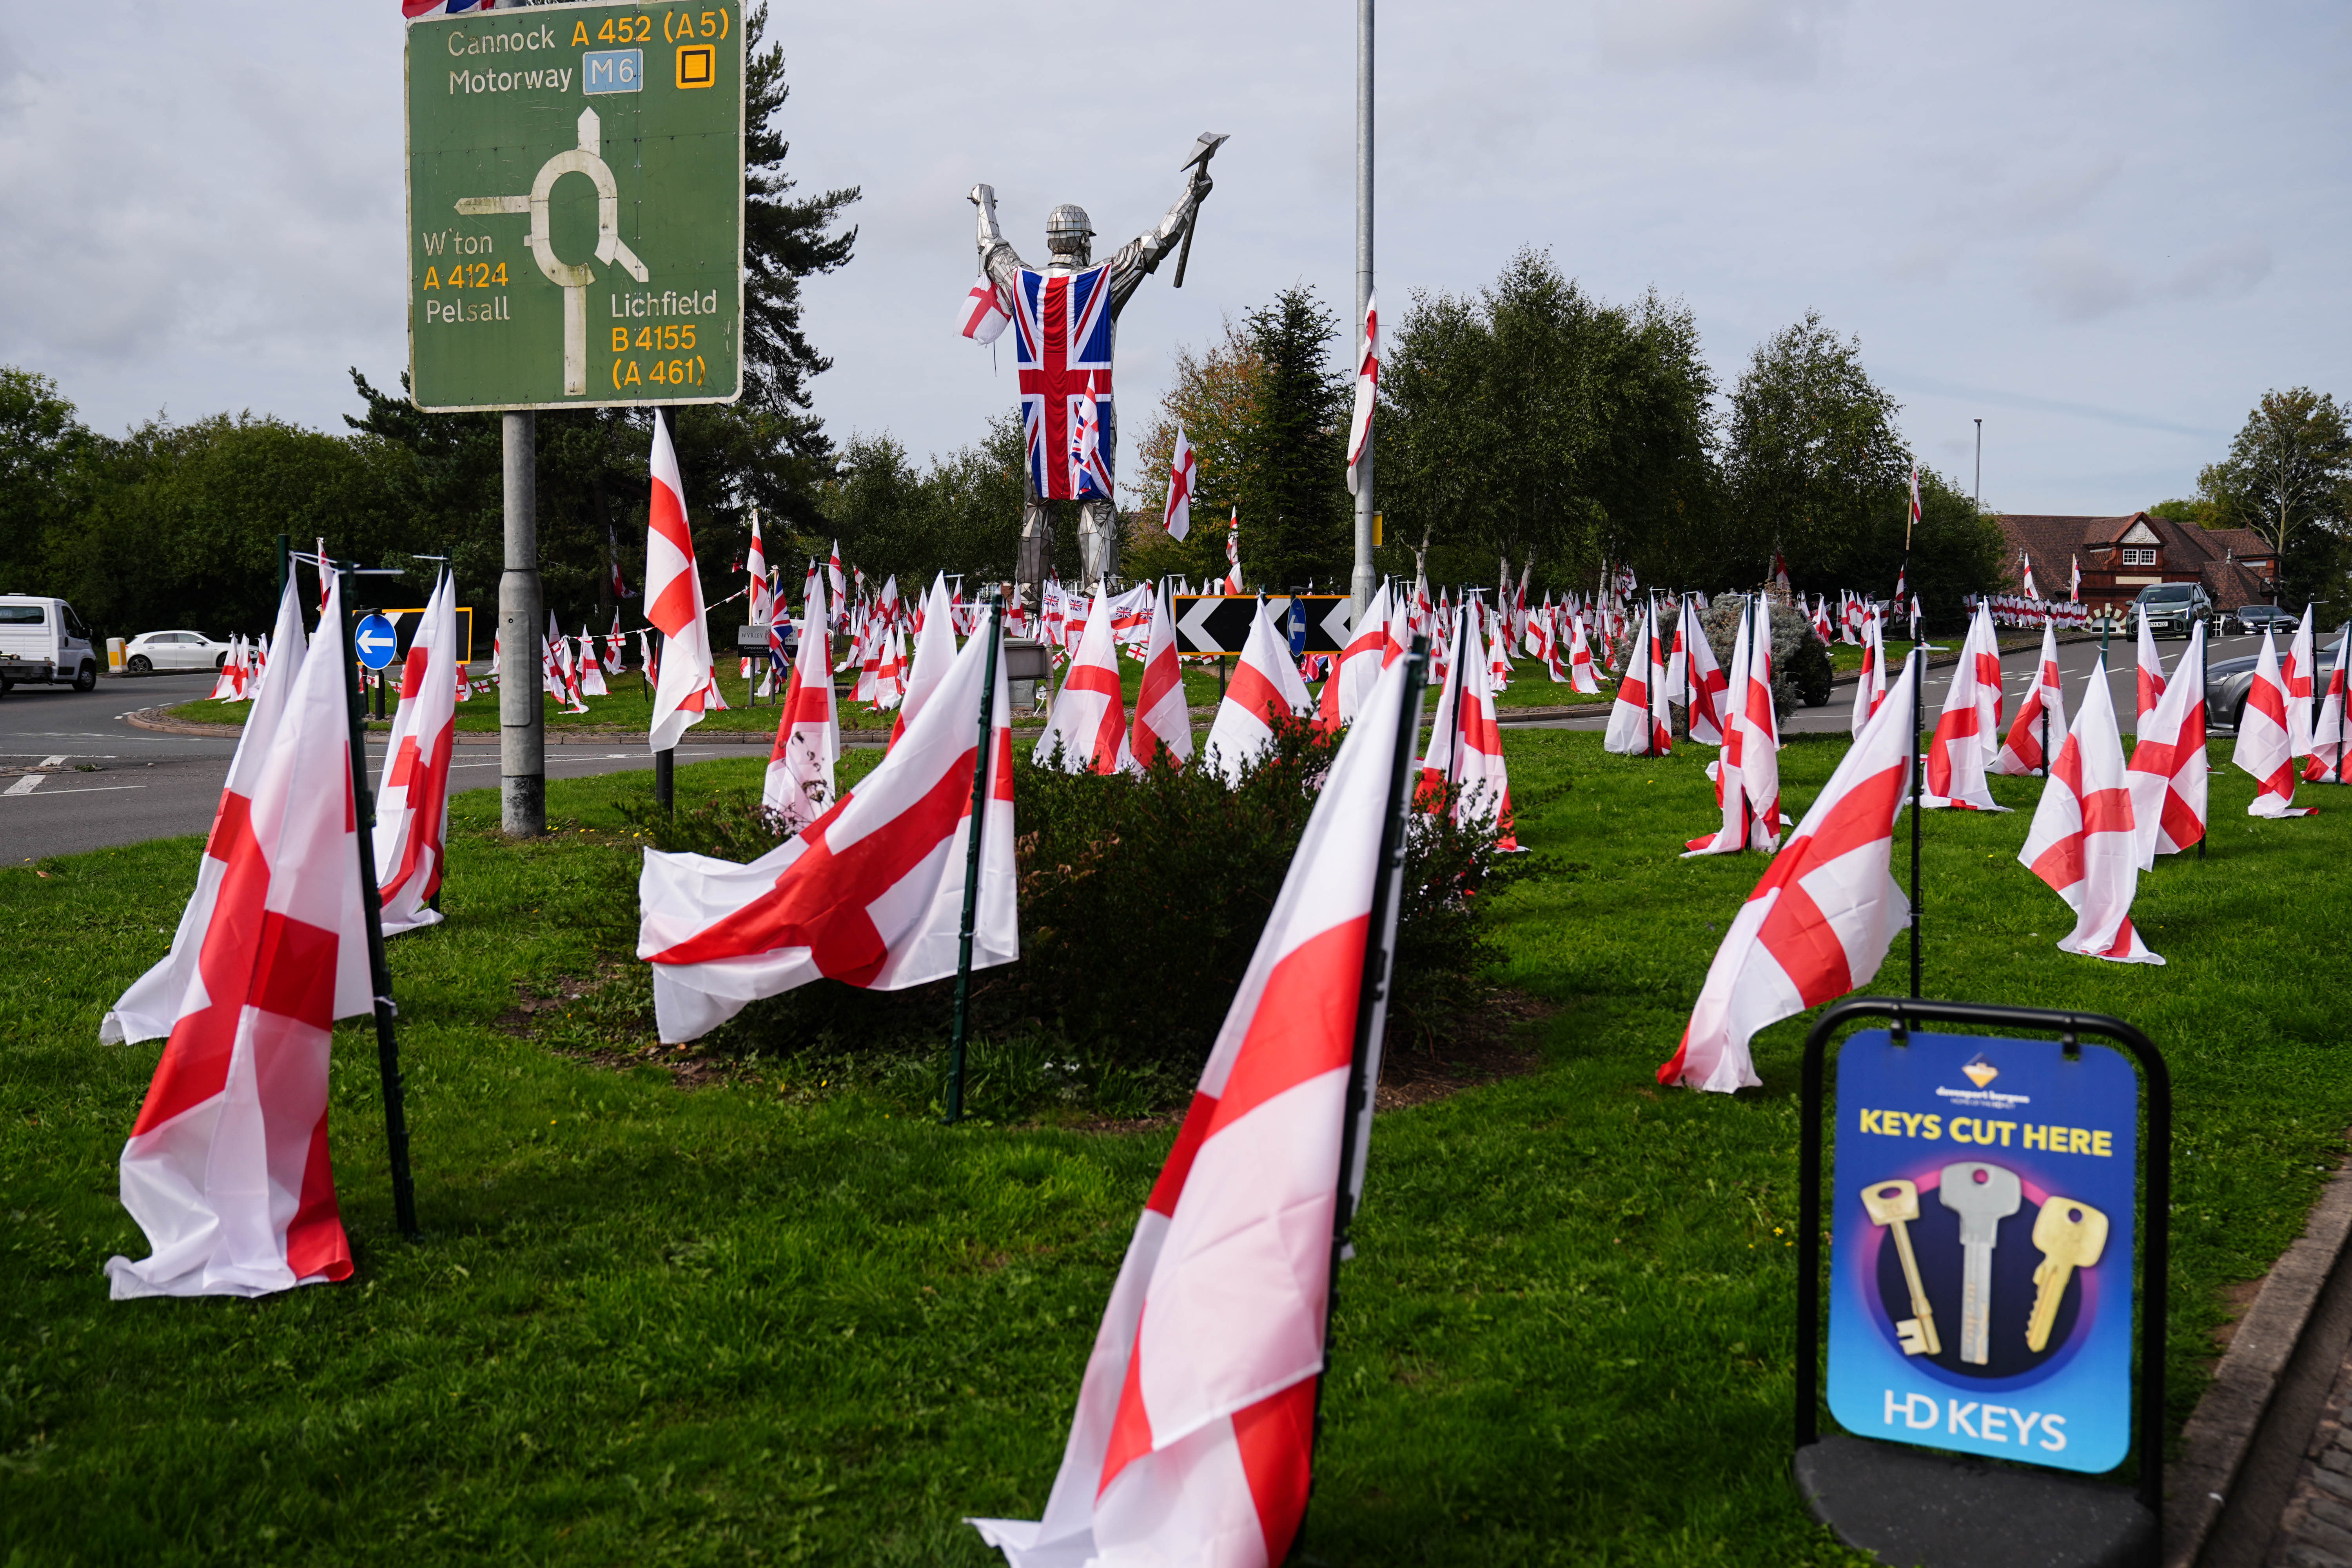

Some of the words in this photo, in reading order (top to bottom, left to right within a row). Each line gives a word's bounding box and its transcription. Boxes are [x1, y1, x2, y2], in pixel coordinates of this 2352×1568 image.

[448, 24, 555, 56] Cannock
[571, 21, 590, 47] A
[598, 15, 651, 44] 452
[449, 67, 573, 95] Motorway
[423, 266, 441, 290] A
[448, 262, 508, 289] 4124
[427, 296, 510, 323] Pelsall
[612, 289, 717, 318] Lichfield
[612, 327, 629, 352] B
[635, 325, 696, 351] 4155
[1860, 1109, 1942, 1140] KEYS
[1949, 1117, 2016, 1146] CUT
[2023, 1124, 2112, 1157] HERE
[1884, 1389, 1940, 1430] HD
[1947, 1399, 2067, 1452] KEYS
